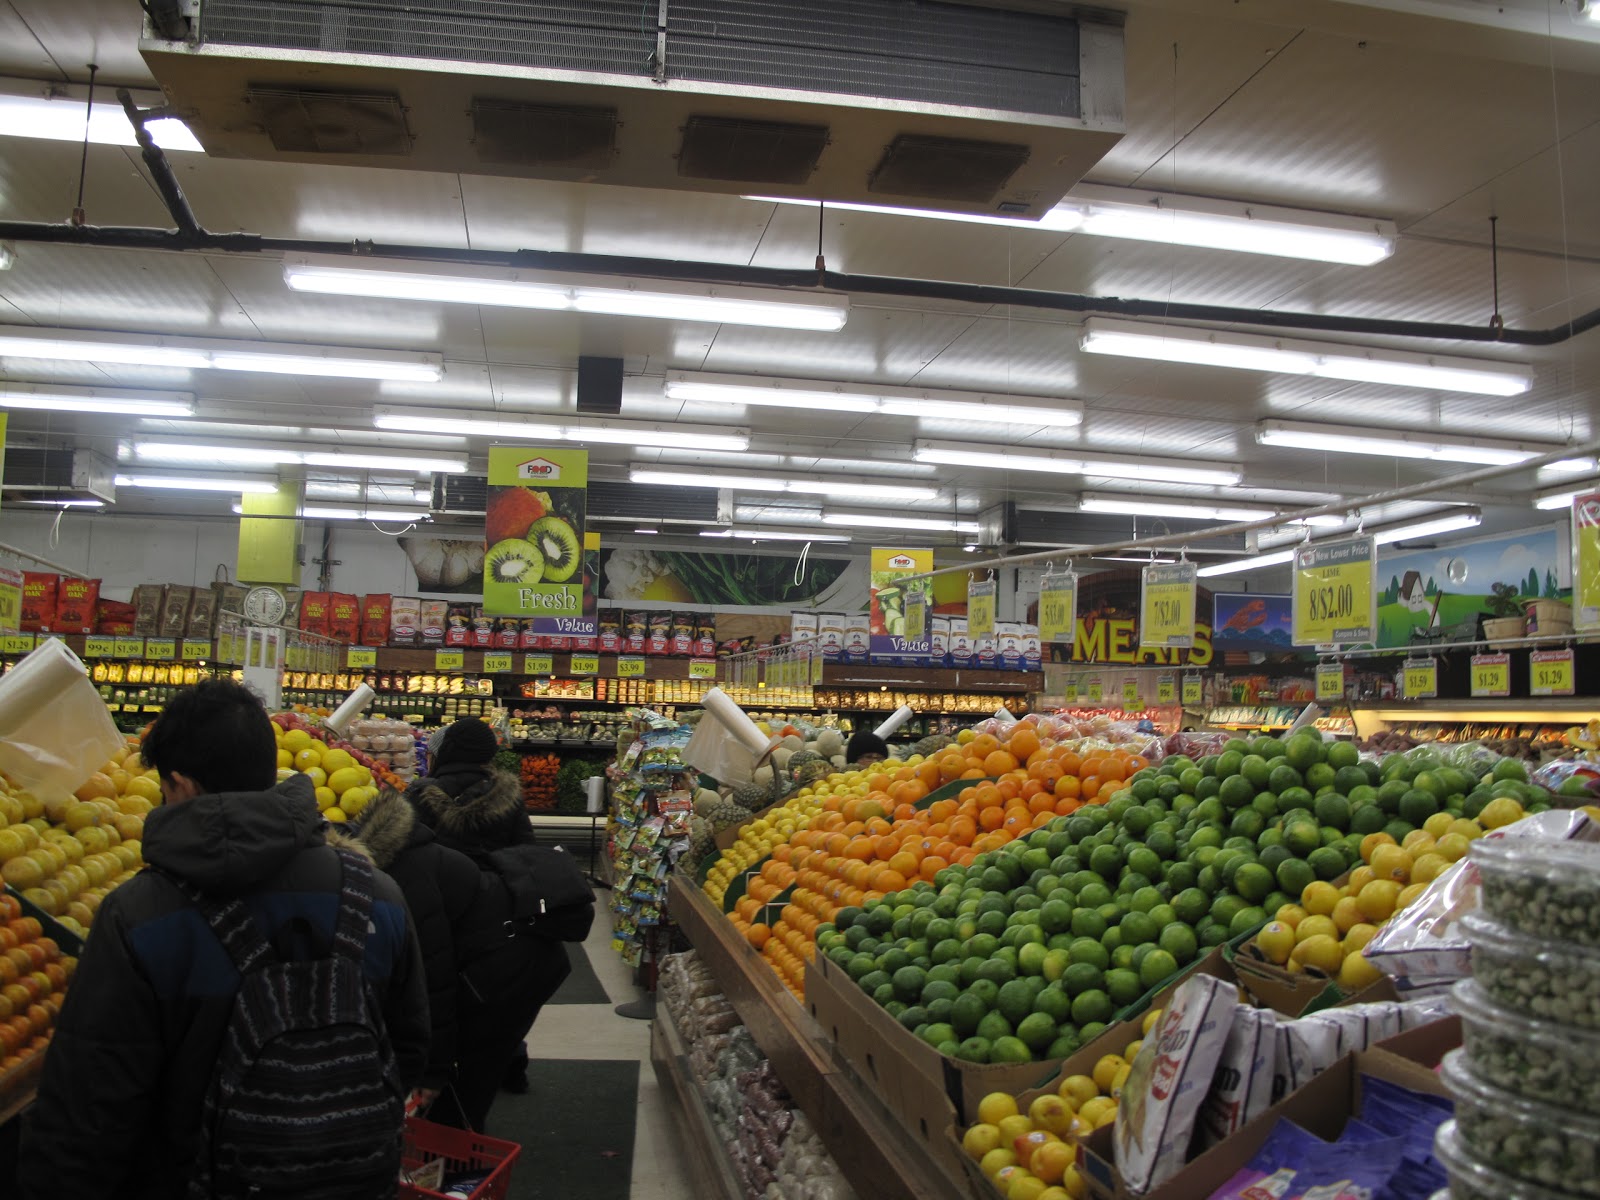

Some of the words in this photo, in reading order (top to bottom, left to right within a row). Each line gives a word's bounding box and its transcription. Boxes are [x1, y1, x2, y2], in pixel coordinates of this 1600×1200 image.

[527, 465, 553, 474] FOOD
[1330, 548, 1350, 560] Lower
[1351, 544, 1369, 556] Price
[1322, 567, 1341, 579] LIME
[518, 585, 577, 610] Fresh
[1309, 583, 1353, 622] 8/$2.00
[554, 618, 594, 633] Value
[7, 641, 29, 650] $1.29
[117, 644, 139, 654] $1.99
[890, 637, 930, 652] Value
[149, 646, 170, 656] $1.99
[184, 645, 206, 656] $1.29
[486, 660, 508, 669] $1.99
[527, 662, 548, 671] $1.99
[573, 662, 594, 671] $1.99
[620, 664, 640, 672] $3.99
[1478, 672, 1499, 687] $1.29
[1538, 669, 1563, 686] $1.29
